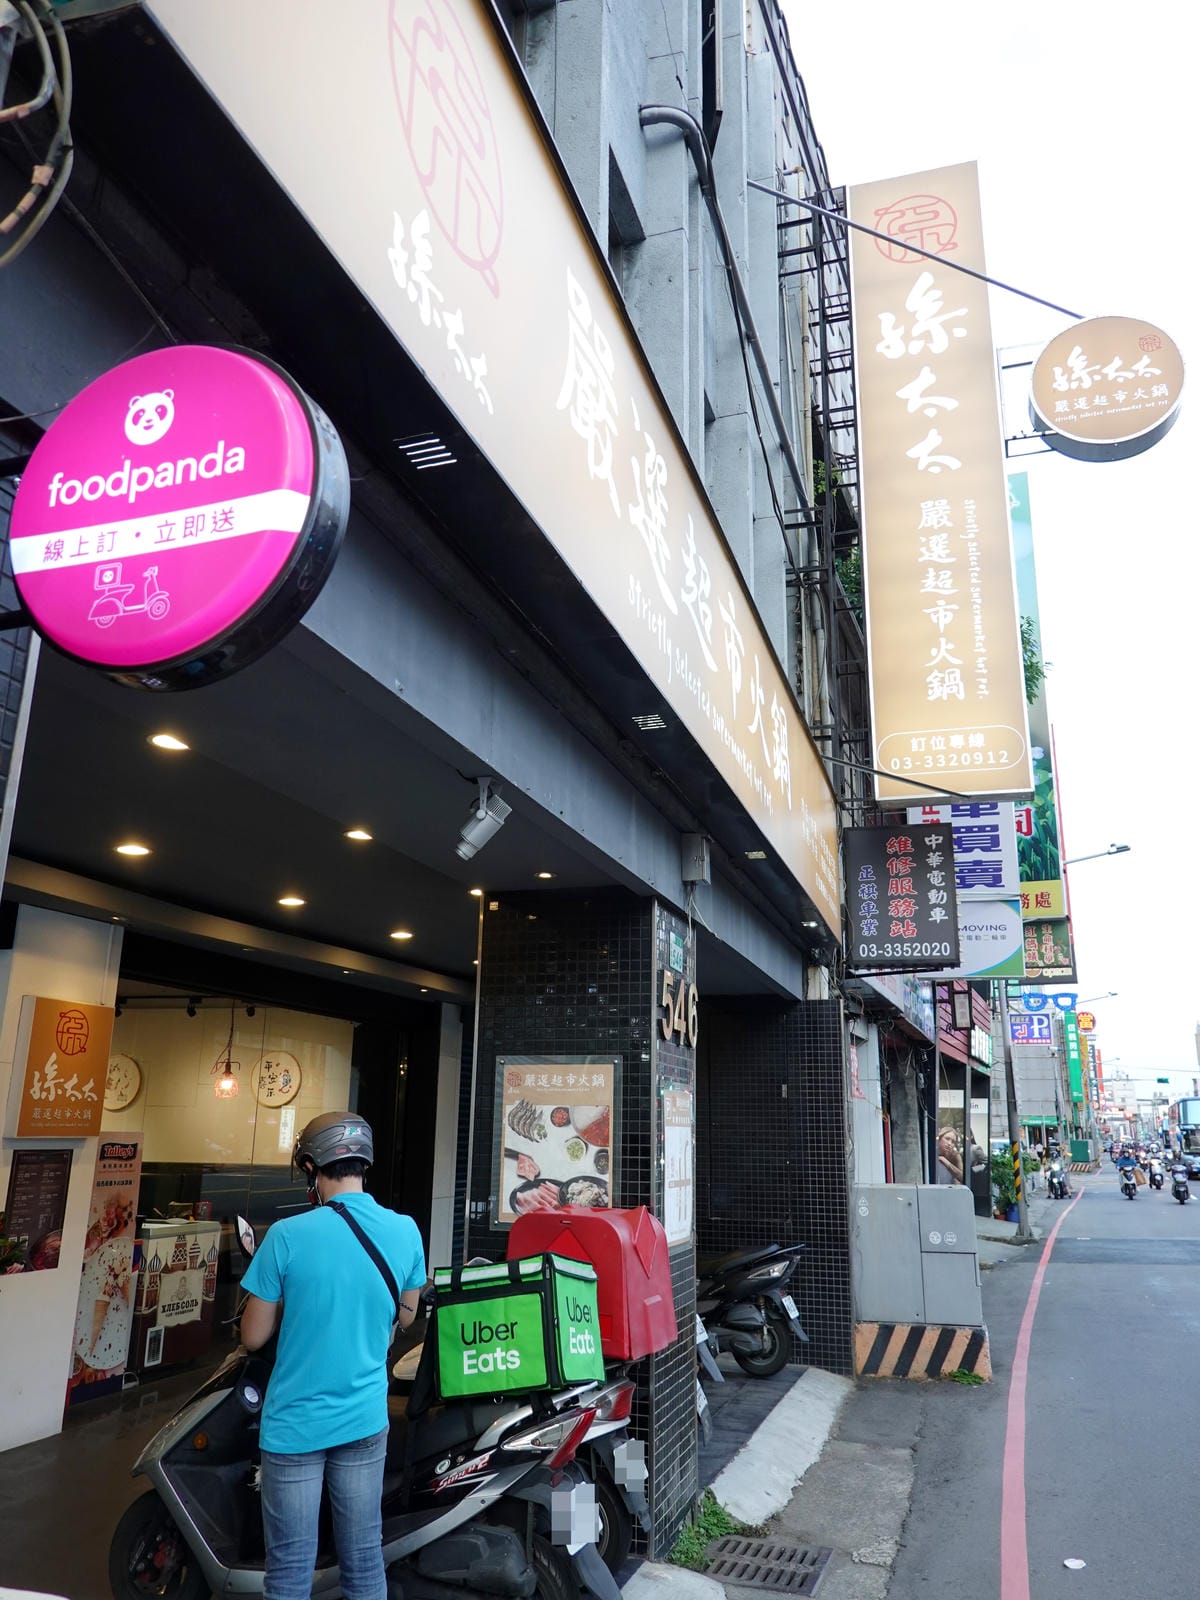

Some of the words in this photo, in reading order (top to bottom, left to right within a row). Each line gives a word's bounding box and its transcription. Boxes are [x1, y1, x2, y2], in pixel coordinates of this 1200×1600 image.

[1054, 383, 1169, 413] 嚴選超市火鍋
[48, 440, 245, 507] foodpanda
[917, 498, 965, 701] 嚴選超市火鍋
[911, 733, 985, 752] 訂位專線
[890, 750, 1009, 770] 03-3320912
[886, 836, 918, 939] 維修服務站
[924, 834, 948, 924] 中華電動車
[860, 942, 950, 957] 03-3352020
[662, 969, 699, 1050] 546
[523, 1073, 605, 1088] 嚴選超市火鍋
[460, 1319, 518, 1345] Uber
[569, 1327, 595, 1354] Eats
[463, 1347, 520, 1375] Eats
